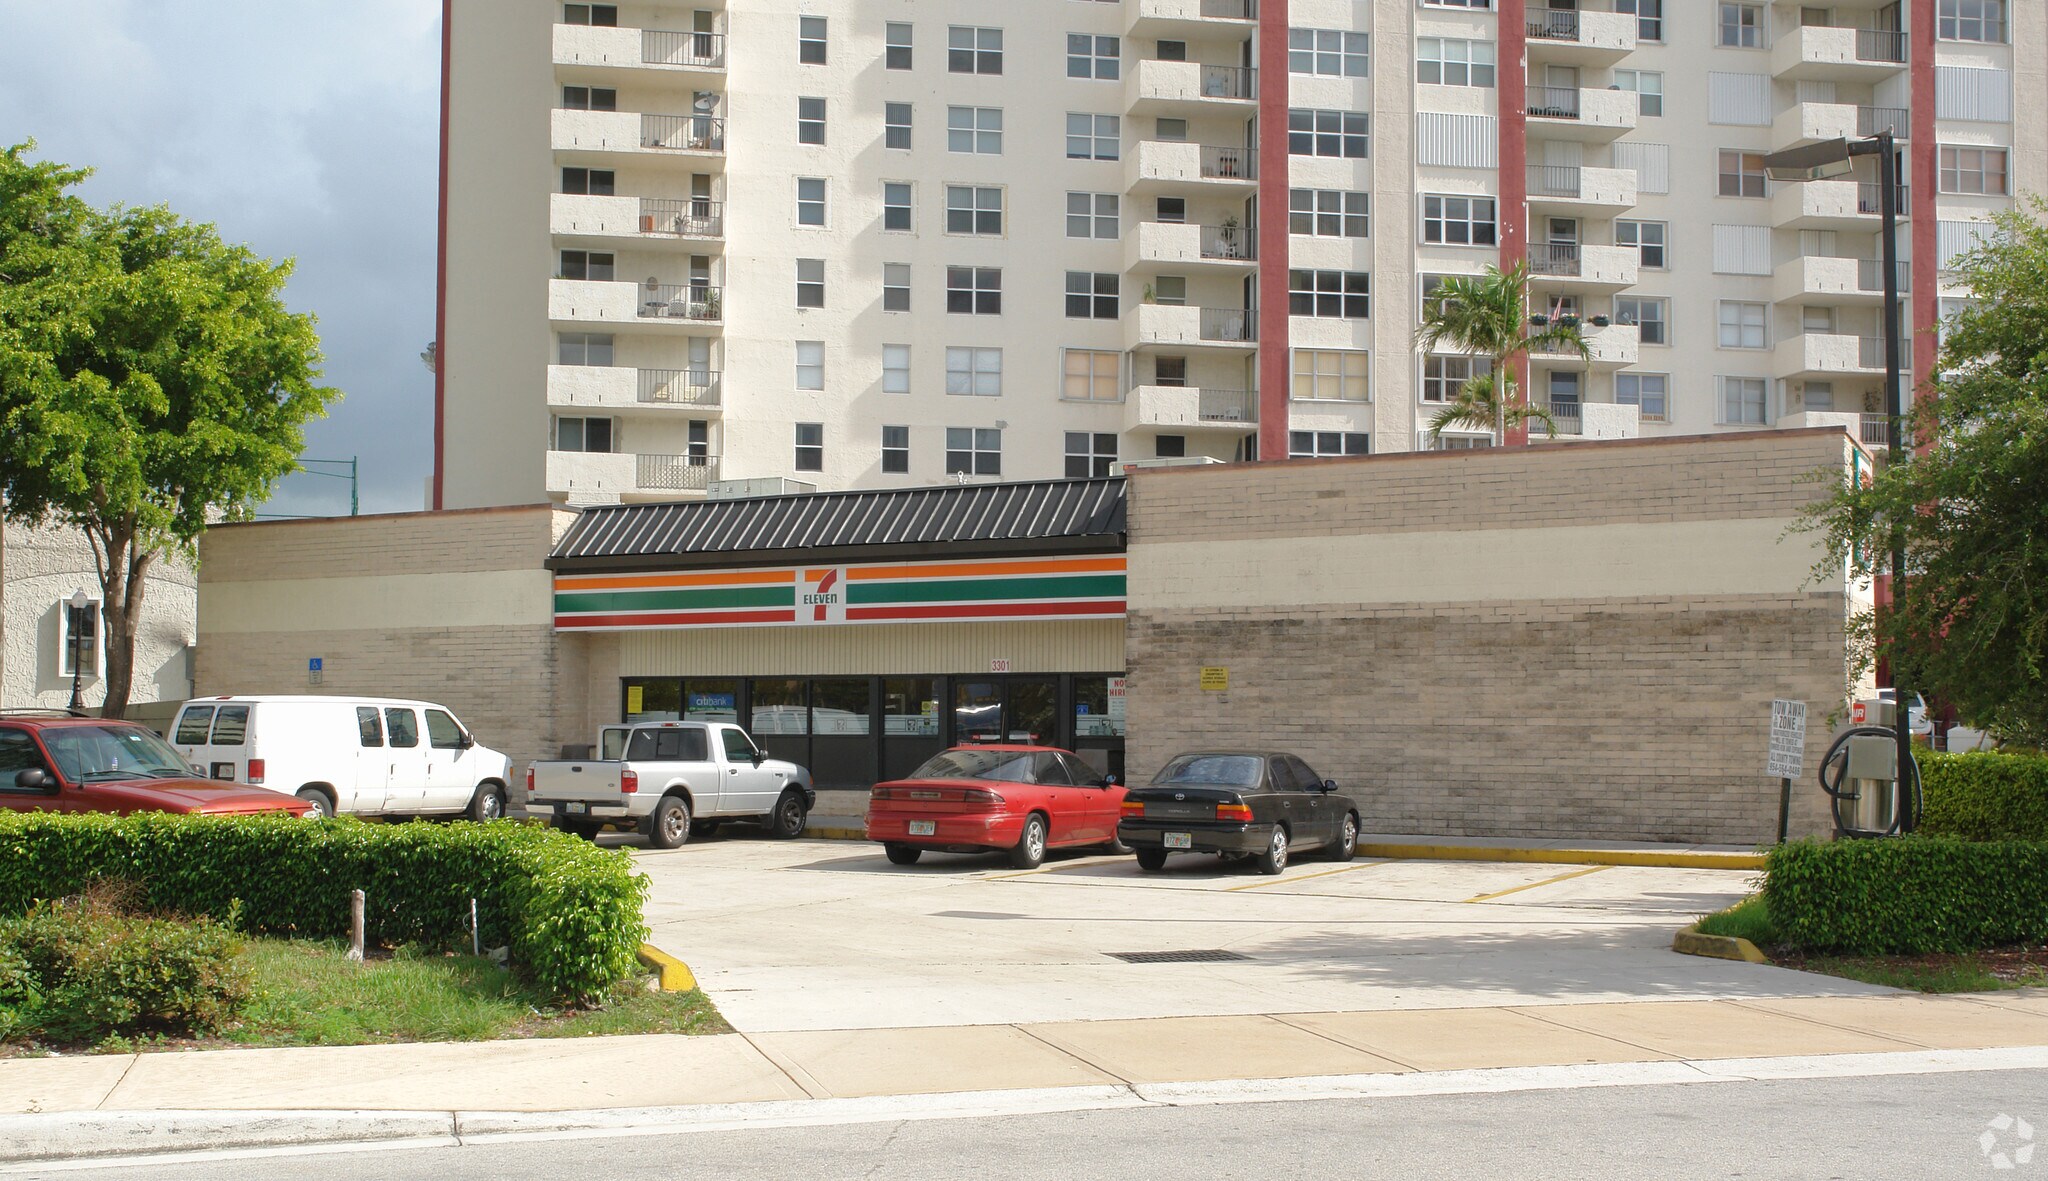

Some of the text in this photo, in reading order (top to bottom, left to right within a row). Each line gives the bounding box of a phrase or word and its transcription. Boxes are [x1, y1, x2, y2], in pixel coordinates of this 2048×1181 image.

[991, 660, 1009, 671] 3301
[696, 696, 727, 706] citibank
[1787, 701, 1804, 717] AWAY
[1779, 715, 1796, 730] ZONE
